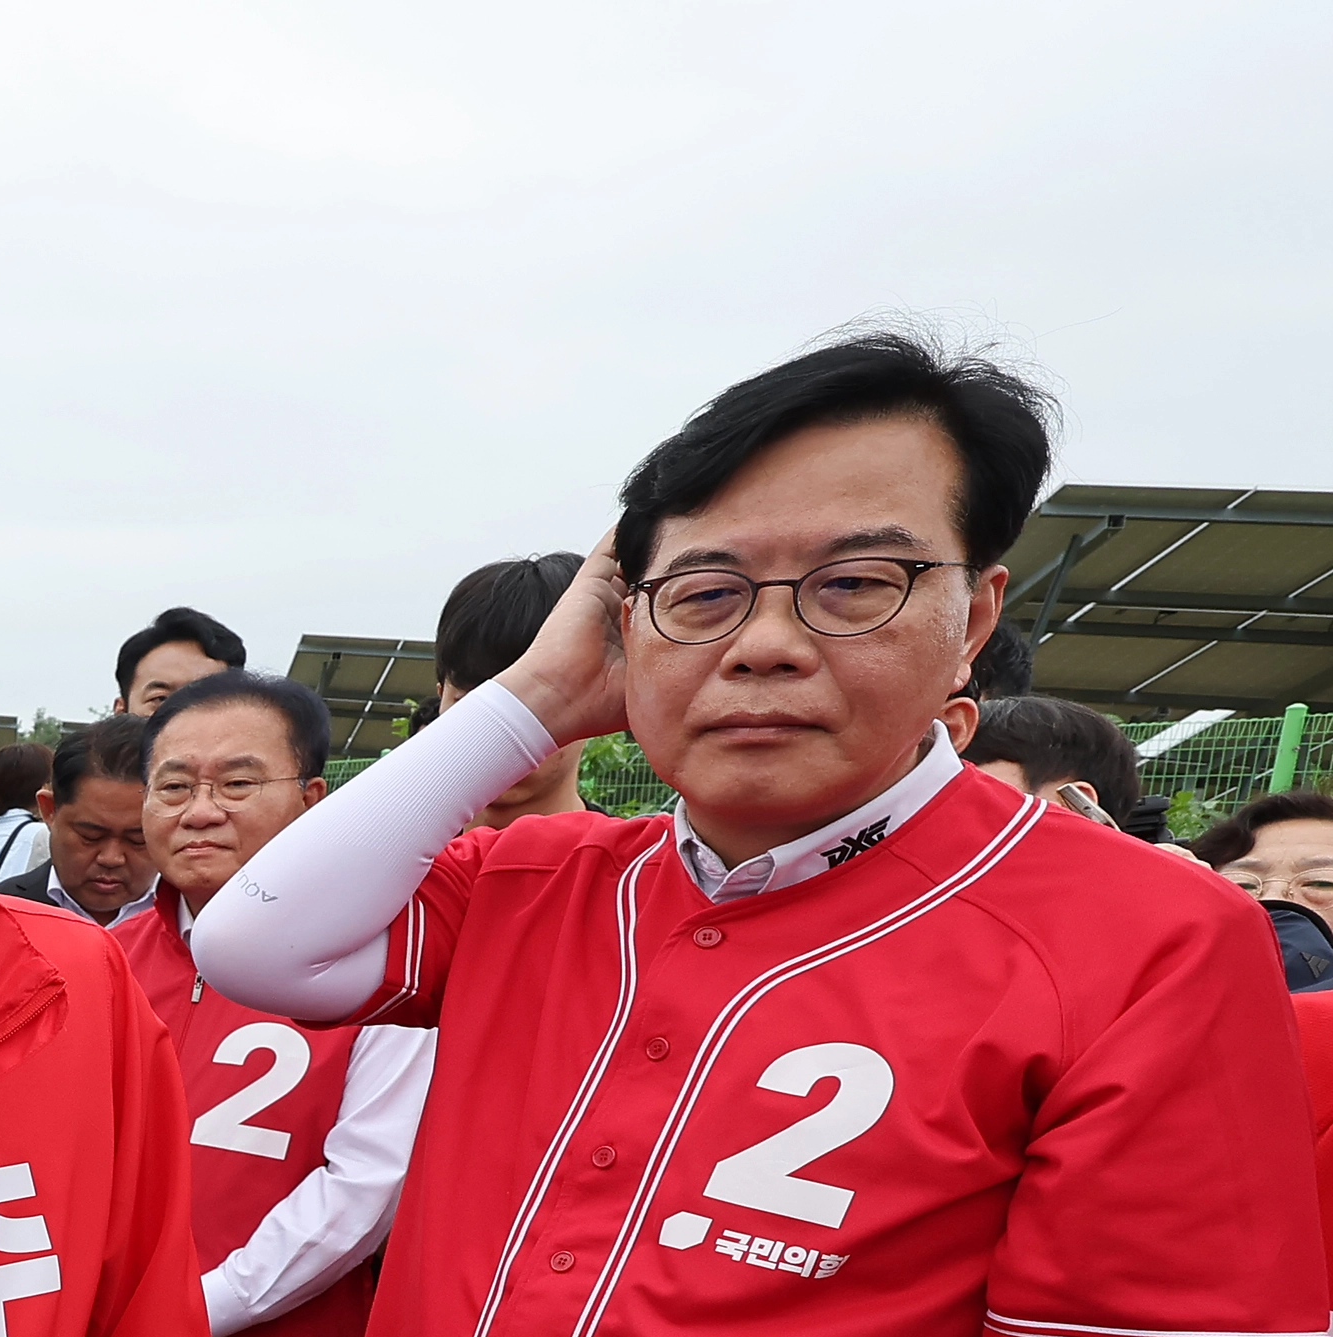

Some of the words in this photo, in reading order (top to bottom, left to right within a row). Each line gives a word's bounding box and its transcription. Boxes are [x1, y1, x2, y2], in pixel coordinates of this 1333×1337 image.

[190, 1021, 312, 1161] 2
[703, 1042, 896, 1230] 2
[715, 1229, 851, 1280] 국민의힘
